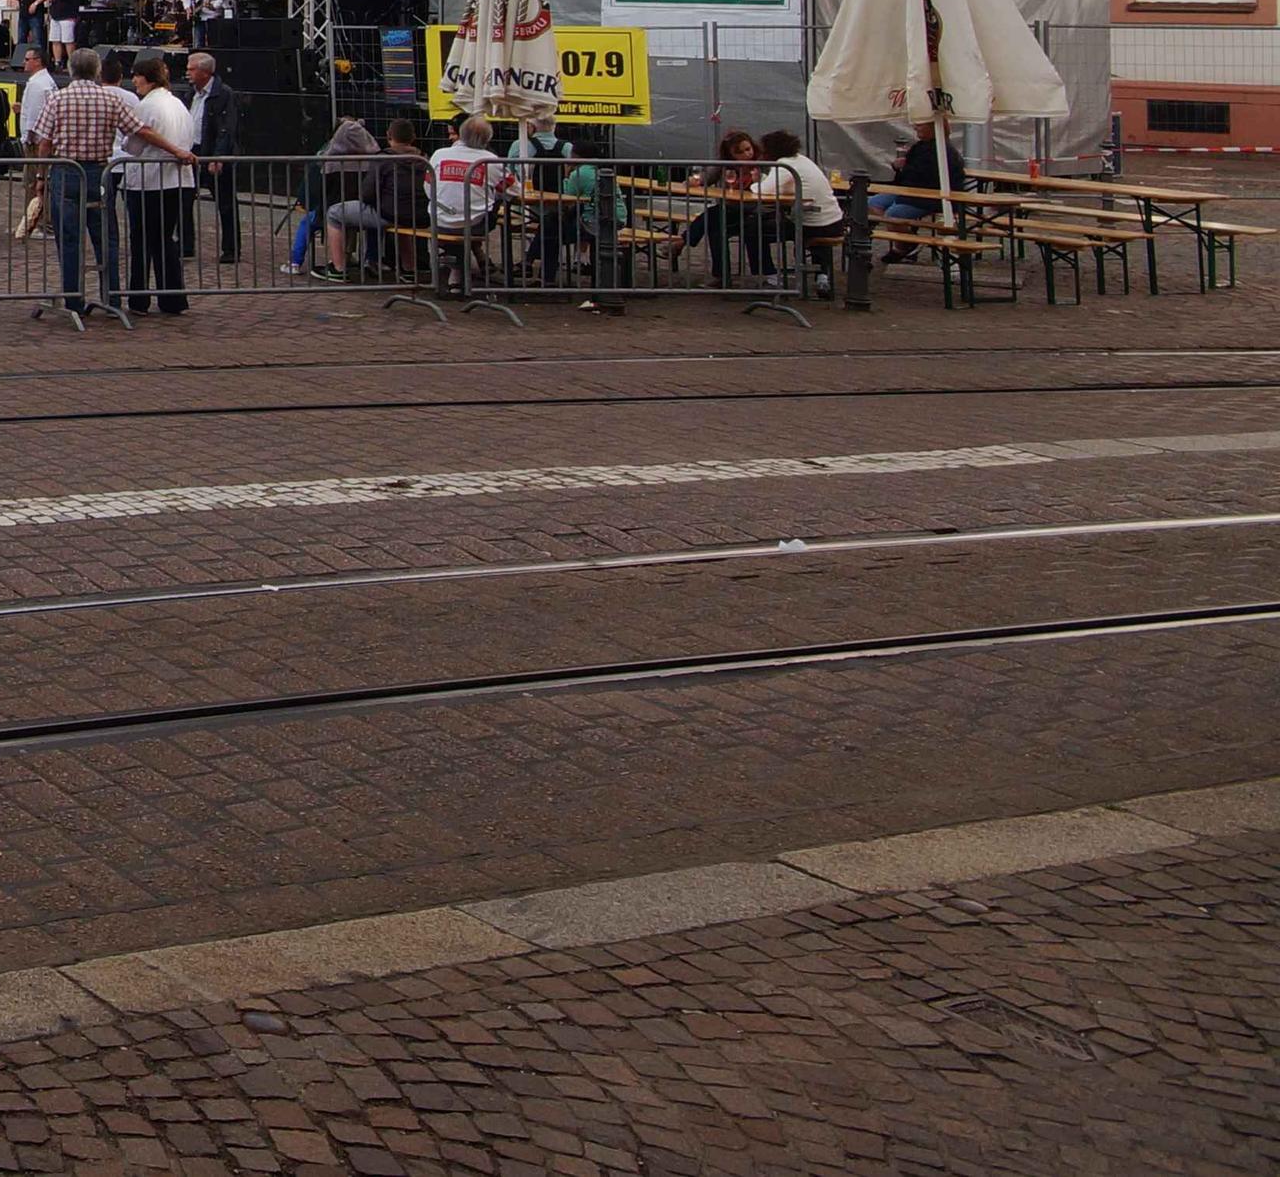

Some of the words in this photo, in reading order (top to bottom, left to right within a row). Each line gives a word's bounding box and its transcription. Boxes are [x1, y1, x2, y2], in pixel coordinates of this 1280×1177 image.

[561, 50, 624, 77] 07.9
[559, 102, 577, 113] wir
[578, 102, 622, 115] wollen!
